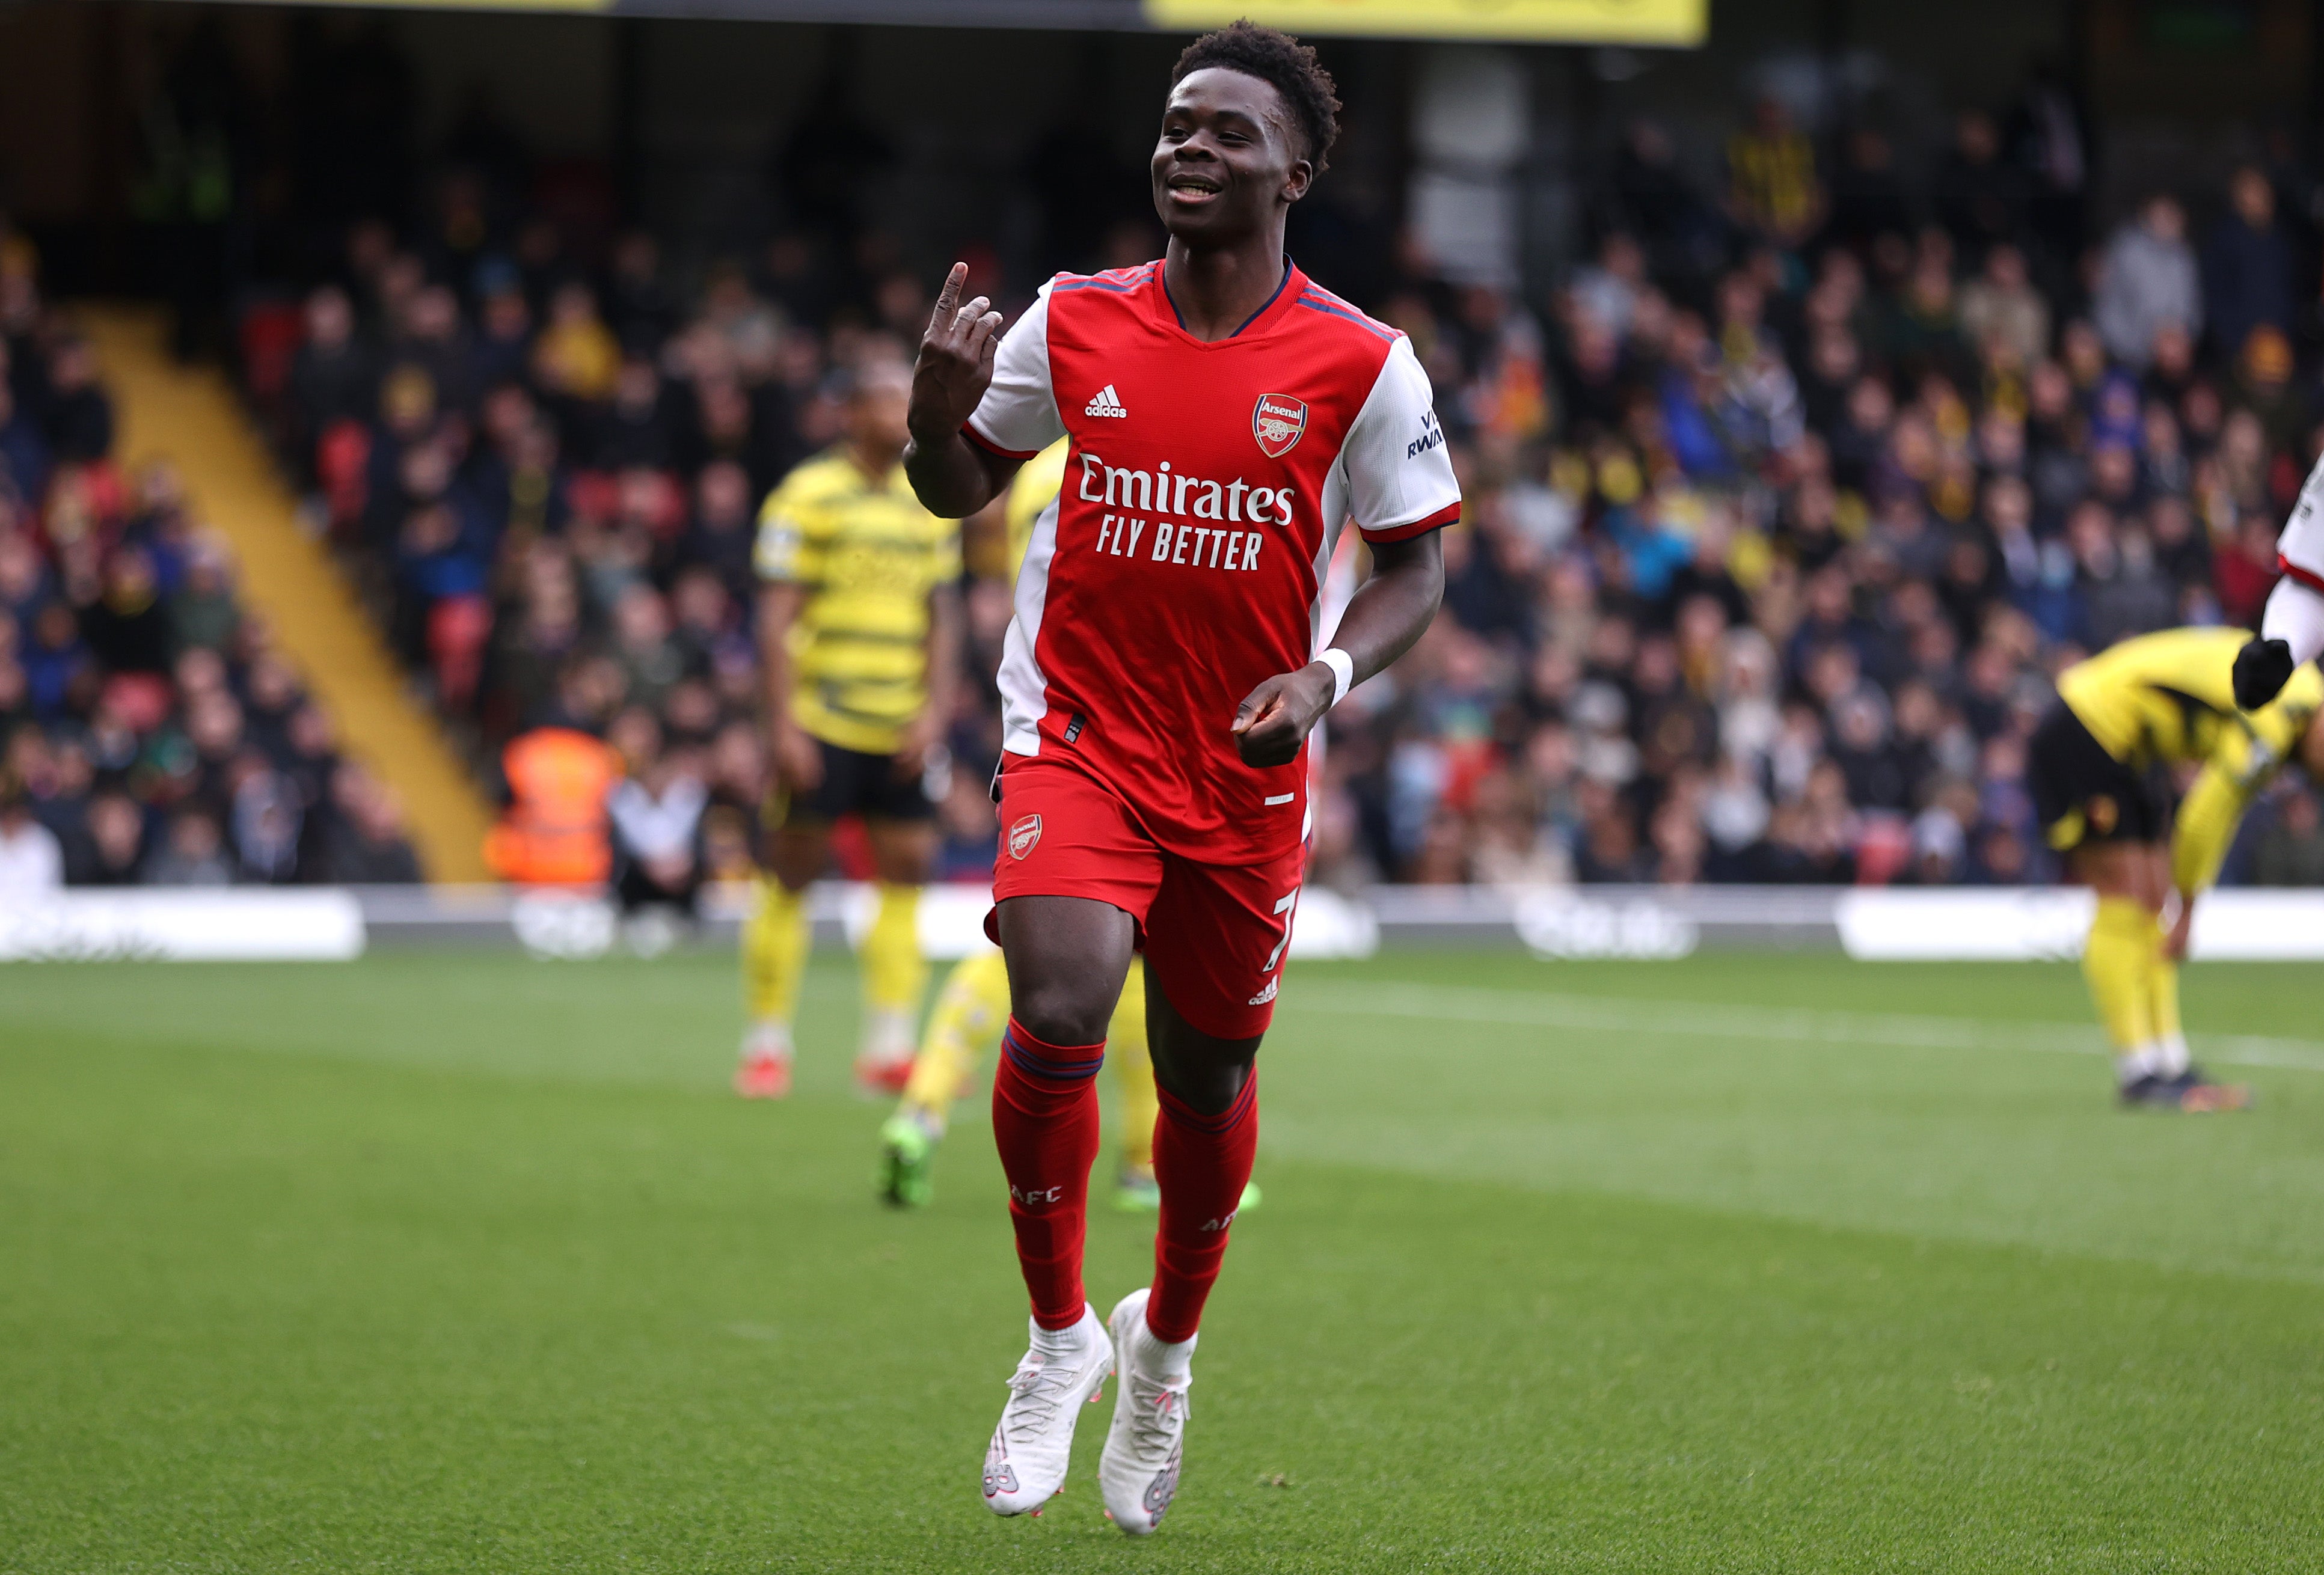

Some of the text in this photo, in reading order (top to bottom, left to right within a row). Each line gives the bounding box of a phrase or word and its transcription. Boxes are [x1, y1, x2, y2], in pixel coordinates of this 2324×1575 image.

[1085, 404, 1127, 418] adidas
[1262, 402, 1301, 420] Arsenal
[1079, 452, 1295, 526] Emirates
[1096, 513, 1263, 571] FLY BETTER
[1262, 886, 1299, 973] 7
[1248, 988, 1278, 1006] adida
[1011, 1184, 1062, 1205] AFC
